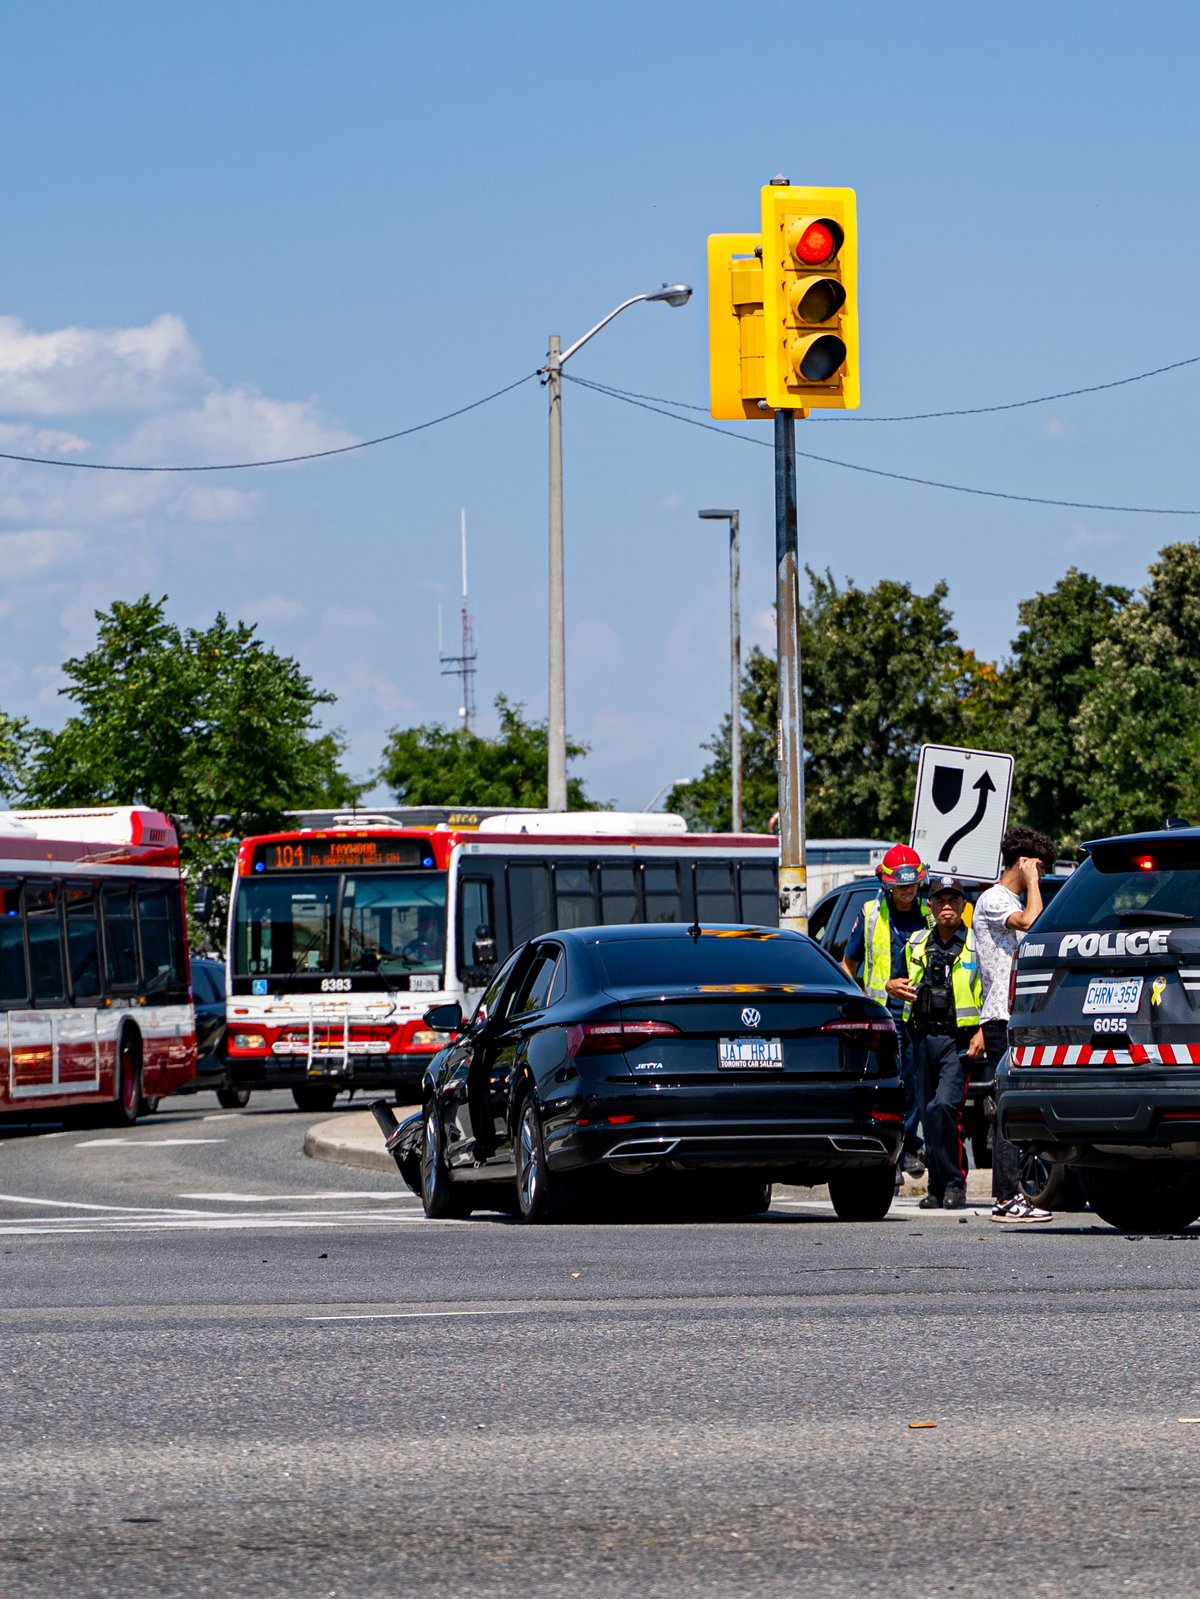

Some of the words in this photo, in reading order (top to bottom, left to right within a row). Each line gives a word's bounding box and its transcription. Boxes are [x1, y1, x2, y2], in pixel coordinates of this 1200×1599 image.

[448, 813, 478, 825] ATCO
[275, 844, 303, 868] 104
[330, 842, 377, 857] FAYWOOD
[1058, 930, 1172, 957] POLICE
[321, 978, 352, 992] 8383
[1093, 1018, 1128, 1032] 6055
[635, 1062, 663, 1070] JETTA
[721, 1060, 746, 1068] TORONTO
[747, 1060, 759, 1068] CAR
